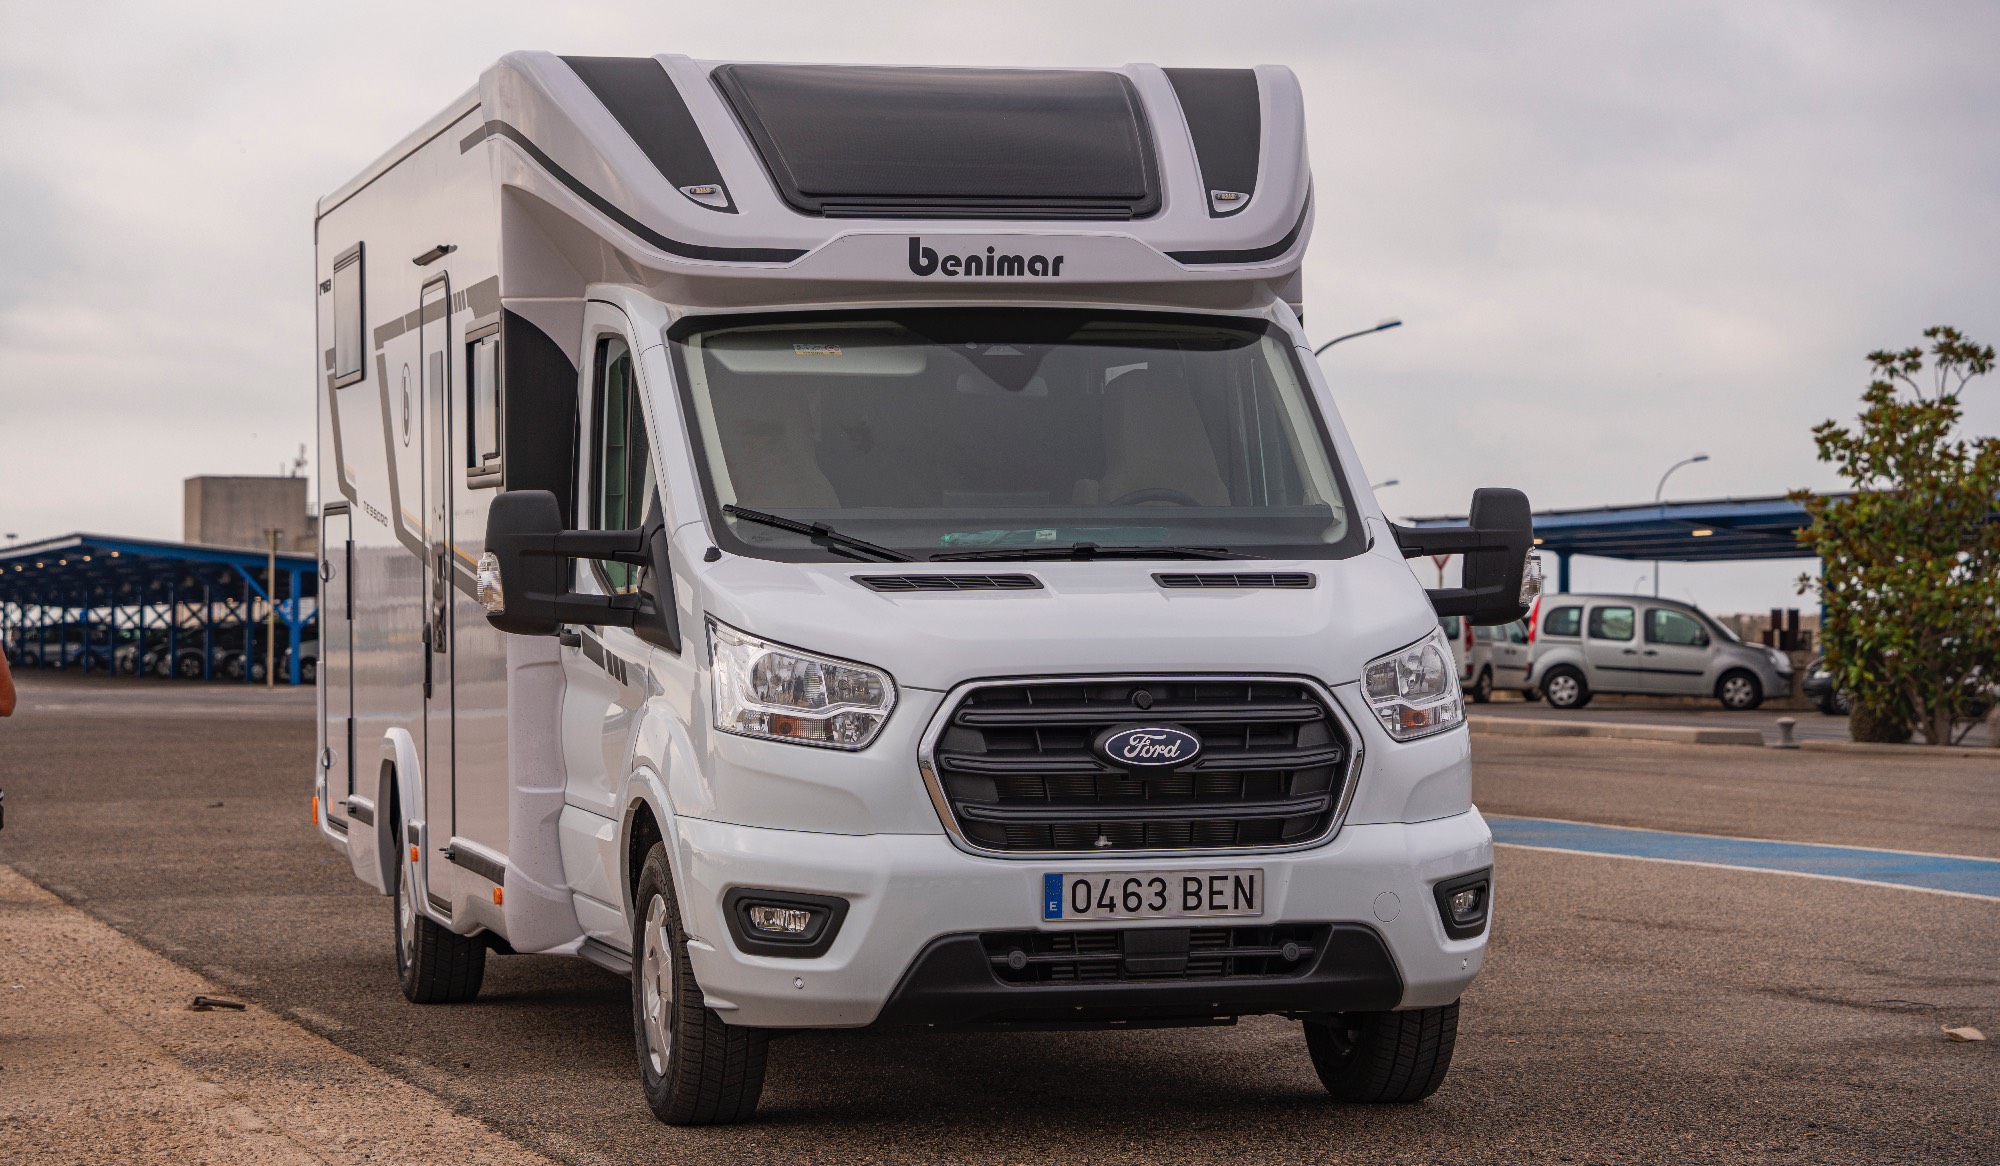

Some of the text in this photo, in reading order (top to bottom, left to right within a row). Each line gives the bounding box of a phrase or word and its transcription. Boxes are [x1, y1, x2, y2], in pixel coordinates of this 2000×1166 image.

[908, 236, 1064, 277] benimar
[363, 500, 388, 528] TESSORO
[1123, 733, 1182, 758] Ford
[1049, 901, 1059, 912] E
[1071, 874, 1255, 914] 0463 BEN
